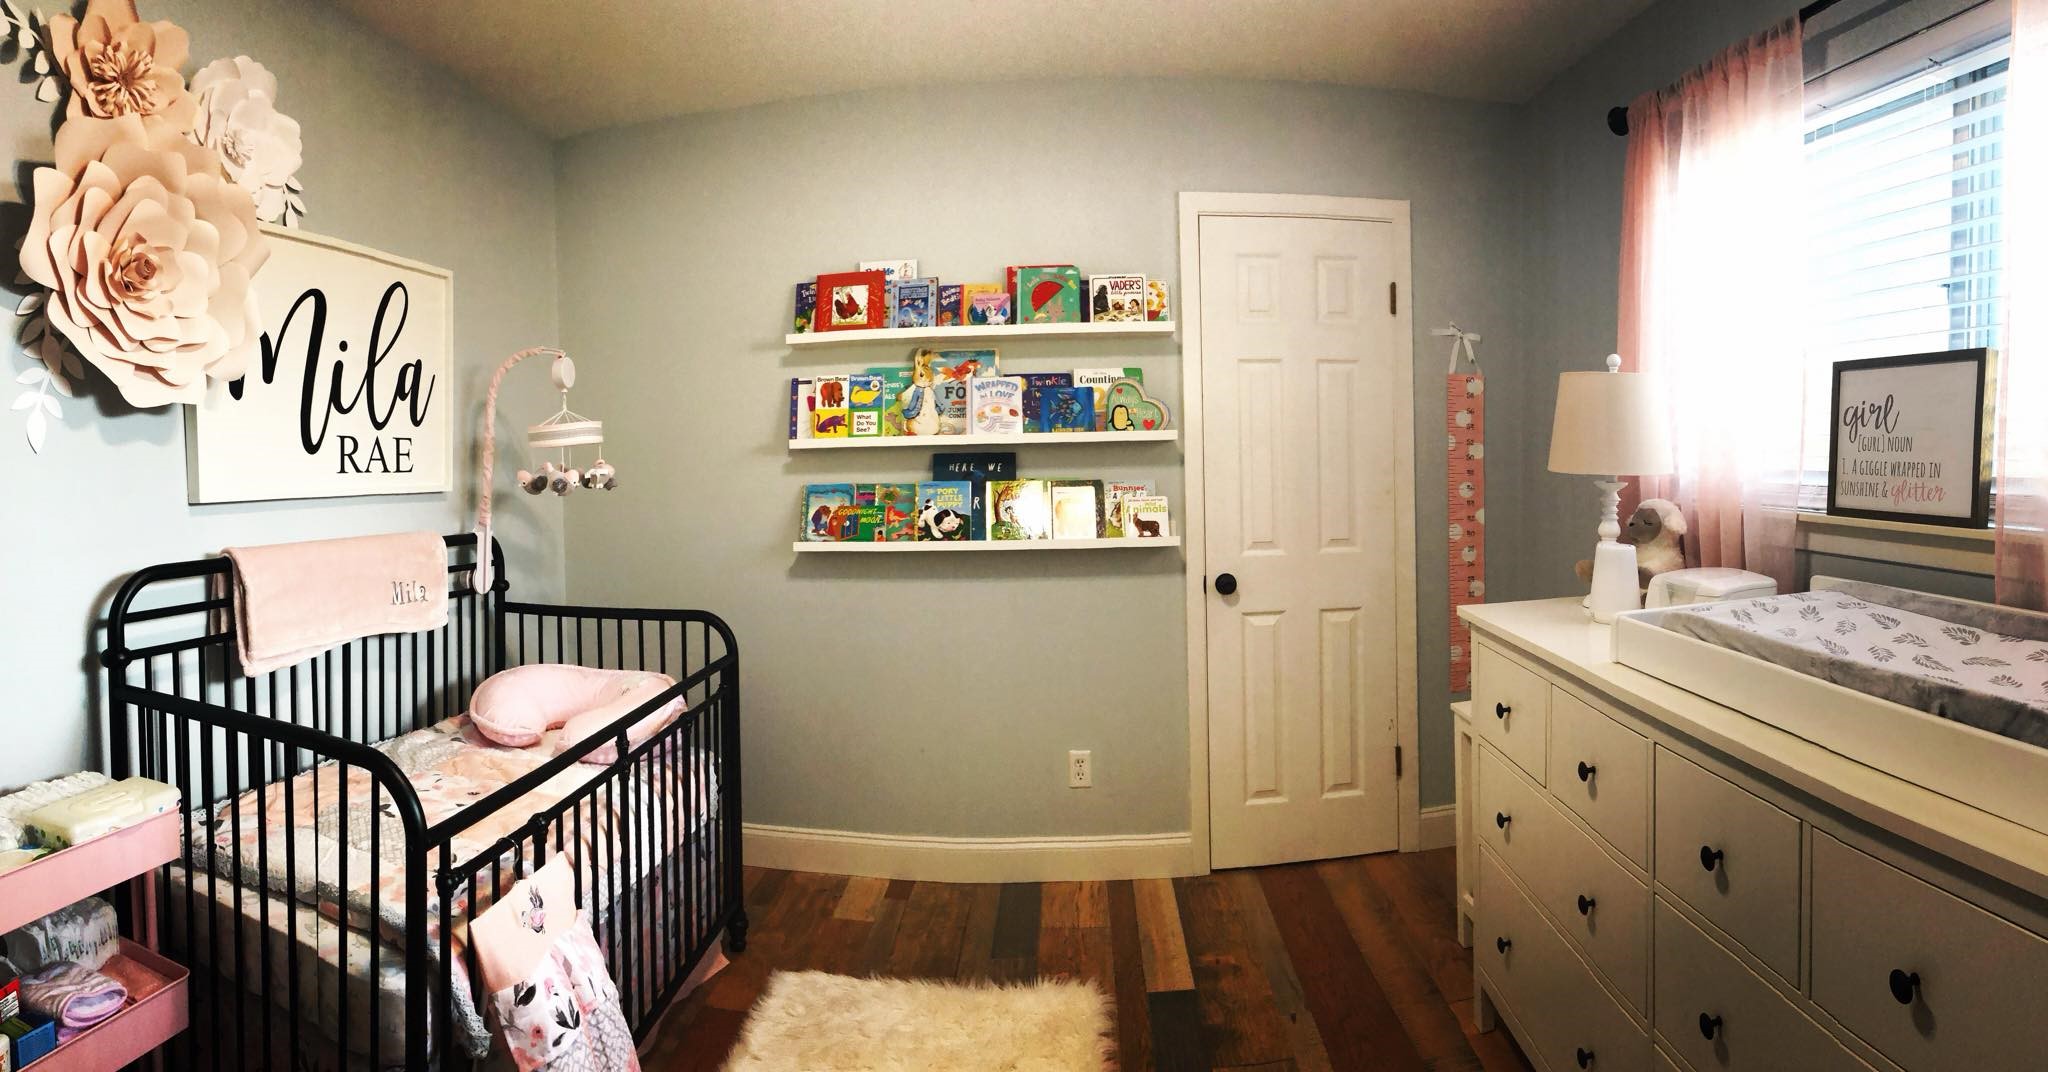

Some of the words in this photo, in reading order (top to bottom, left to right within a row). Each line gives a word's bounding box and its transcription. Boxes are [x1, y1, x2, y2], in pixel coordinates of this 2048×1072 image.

[1109, 279, 1141, 290] VADER'S
[228, 280, 436, 455] Mila
[975, 380, 1018, 391] WRAPPED
[1031, 375, 1067, 386] Twinkle
[1843, 394, 1899, 443] girl
[1857, 434, 1885, 453] [GURL]
[1887, 436, 1913, 453] NOUN
[336, 435, 414, 474] RAE
[949, 463, 976, 472] HERE
[988, 463, 1003, 472] WE
[1851, 459, 1857, 475] A
[1859, 460, 1888, 477] GIGGLE
[1890, 461, 1926, 478] WRAPPED
[1929, 462, 1941, 479] IN
[1840, 479, 1879, 498] SUNSHINE
[1881, 482, 1888, 498] &
[1891, 480, 1946, 505] glitter
[390, 580, 428, 606] Mila
